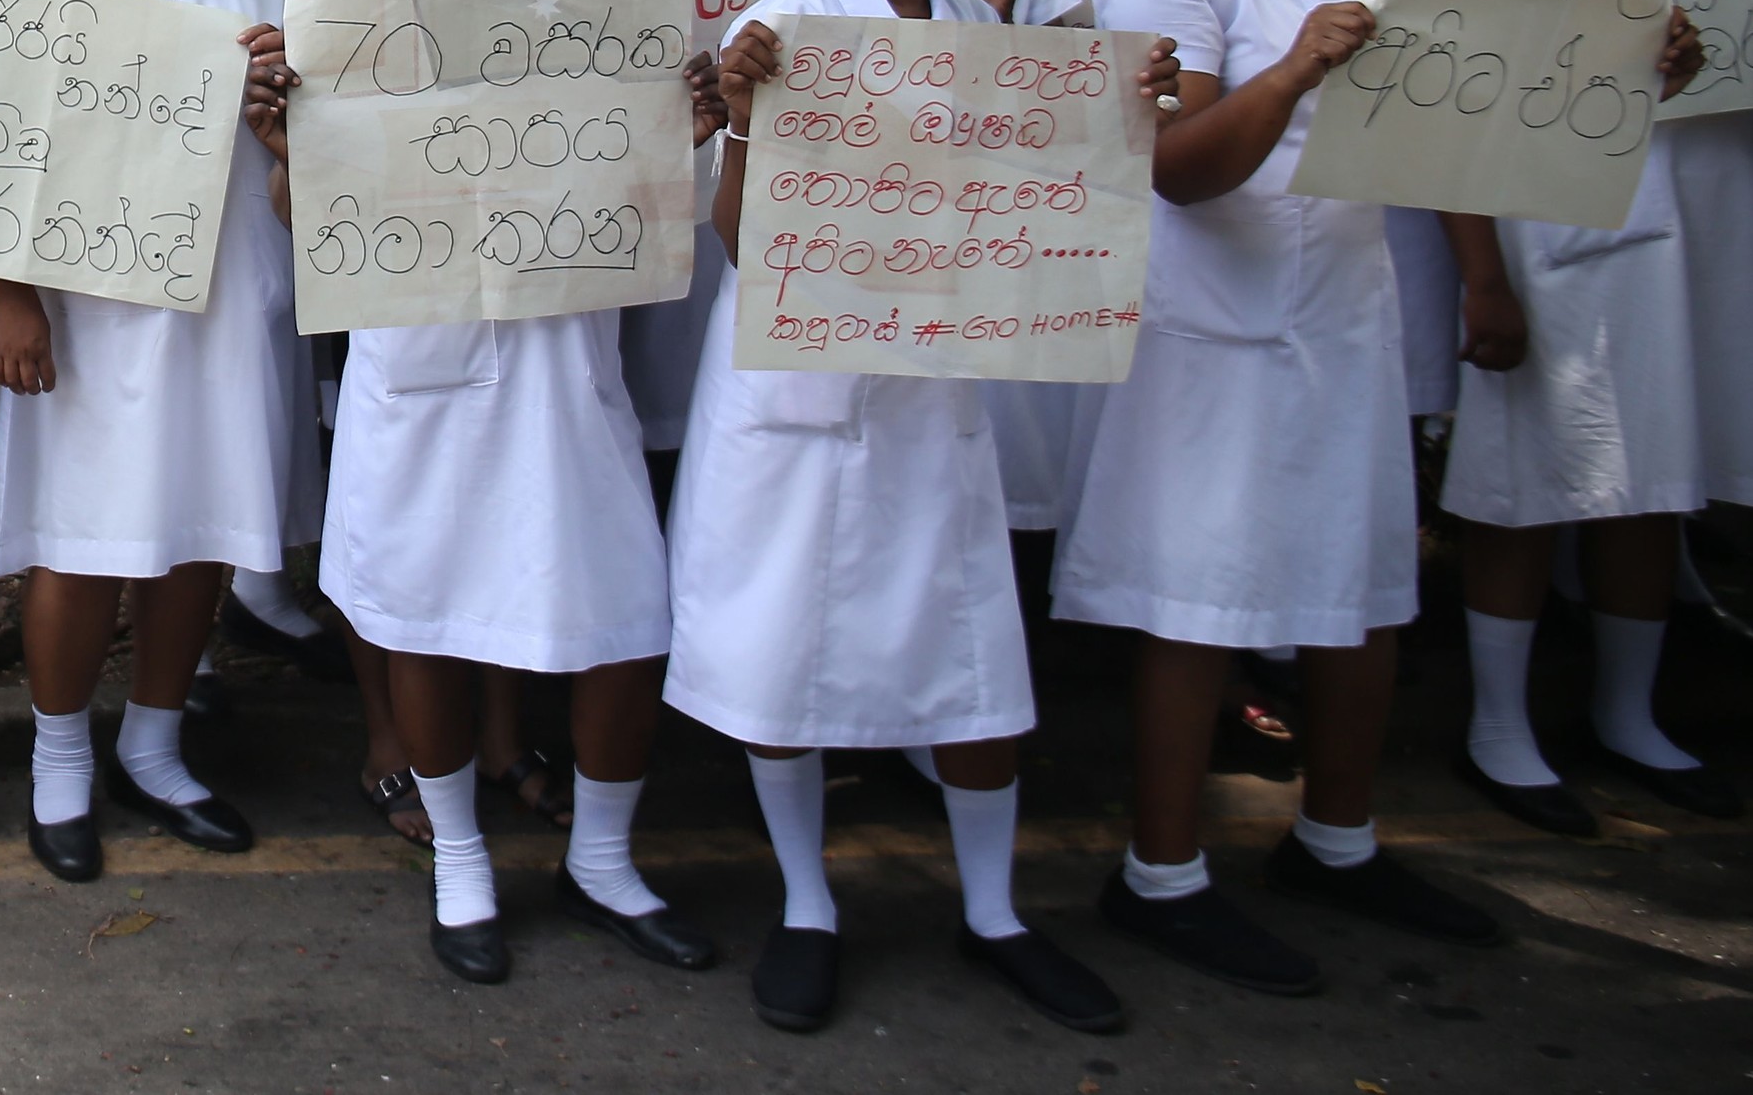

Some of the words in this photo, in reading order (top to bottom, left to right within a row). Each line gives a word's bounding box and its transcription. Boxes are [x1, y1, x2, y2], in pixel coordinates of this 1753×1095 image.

[313, 19, 444, 97] 70
[479, 5, 686, 88] වසරක
[306, 193, 455, 277] නිමා
